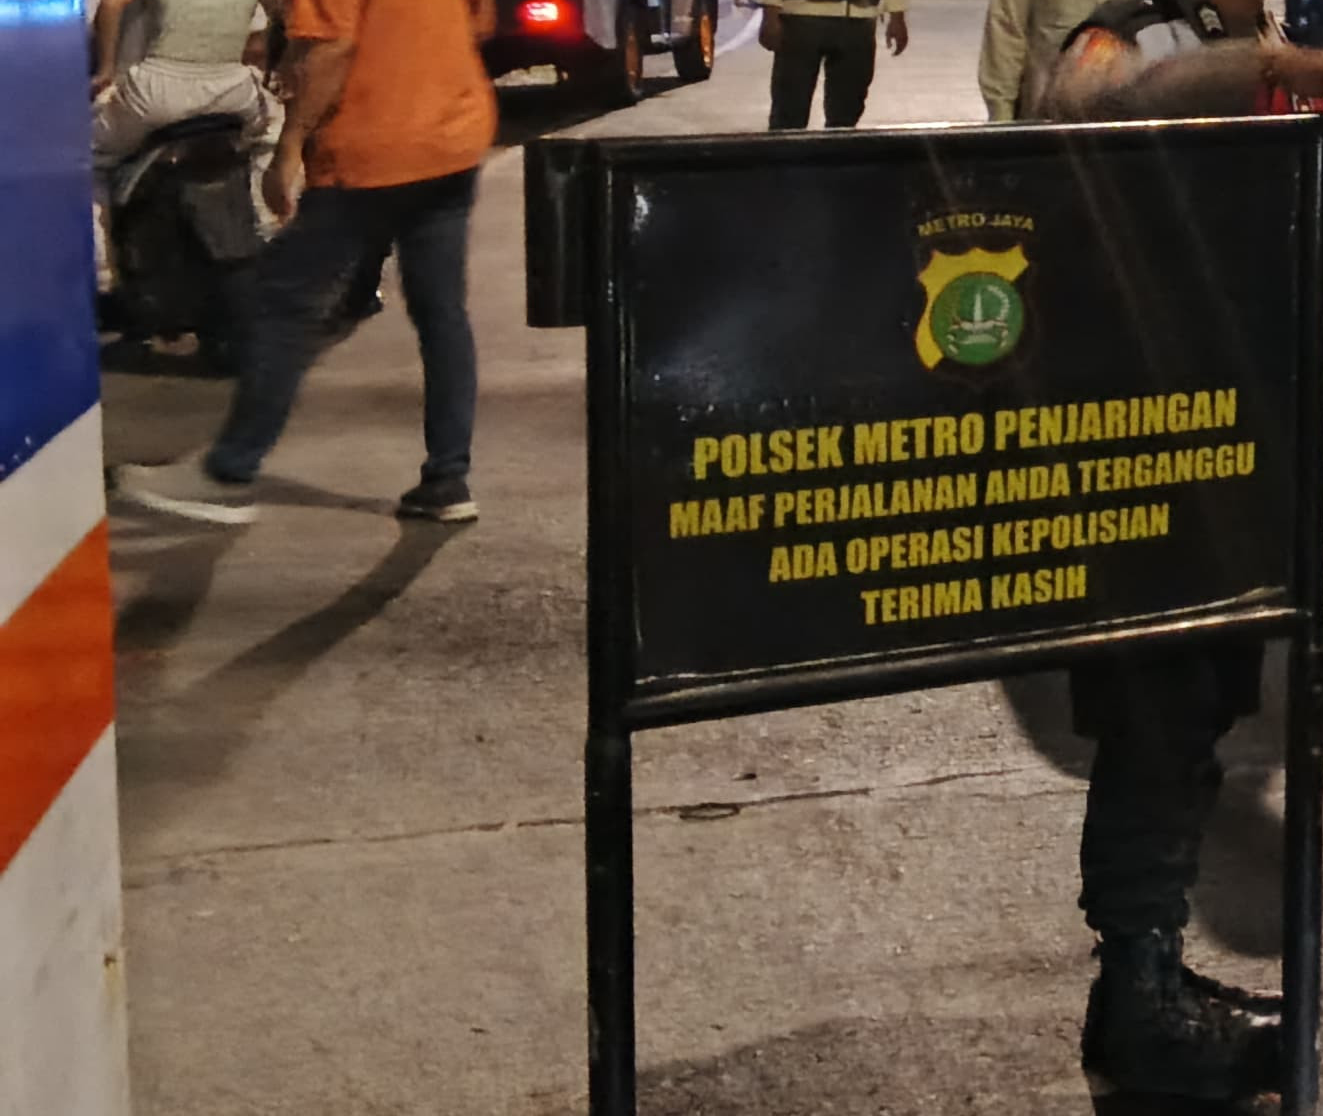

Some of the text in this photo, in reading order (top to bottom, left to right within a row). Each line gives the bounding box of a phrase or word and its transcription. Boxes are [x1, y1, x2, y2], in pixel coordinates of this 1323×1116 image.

[918, 213, 1035, 237] METRO JAYA
[693, 388, 1238, 480] POLSEK METRO PENJARINGAN
[669, 442, 1256, 537] MAAF PERJALANAN ANDA TERGANGGU
[769, 504, 1170, 584] ADA OPERASI KEPOLISIAN
[861, 565, 1088, 625] TERIMA KASIH
